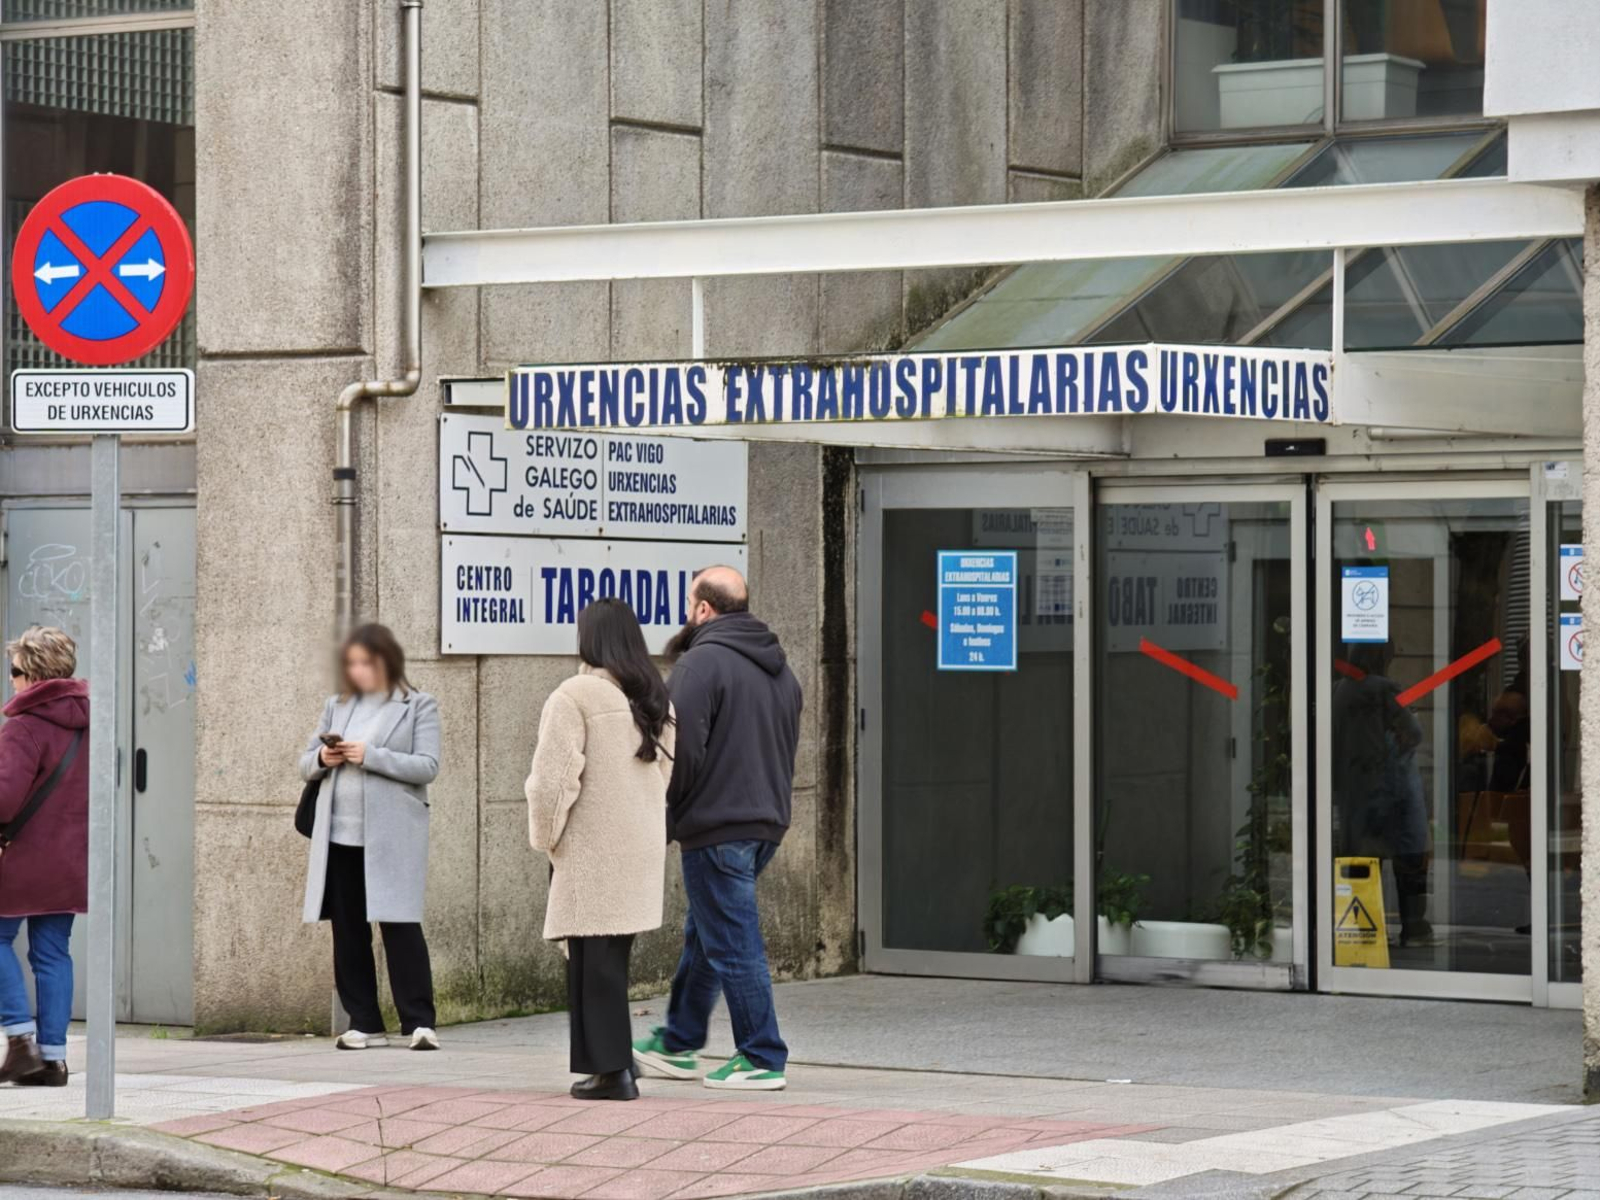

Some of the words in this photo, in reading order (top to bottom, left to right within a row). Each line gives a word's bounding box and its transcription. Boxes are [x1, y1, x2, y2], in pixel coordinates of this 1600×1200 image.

[25, 382, 90, 397] EXCEPTO
[94, 382, 176, 397] VEHICULOS
[508, 365, 706, 430] URXENCIAS
[726, 349, 1148, 422] EXTRAHOSPITALARIAS
[1160, 349, 1329, 422] URXENCIAS
[48, 405, 66, 420] DE
[71, 405, 154, 420] URXENCIAS
[525, 435, 598, 459] SERVIZO
[608, 441, 632, 463] PAC
[636, 442, 664, 464] VIGO
[525, 466, 598, 490] GALEGO
[608, 471, 677, 494] URXENCIAS
[513, 495, 534, 518] de
[543, 493, 598, 521] SAÚDE
[608, 501, 737, 526] EXTRAHOSPITALARIAS
[457, 565, 512, 592] CENTRO
[457, 597, 525, 624] INTEGRAL
